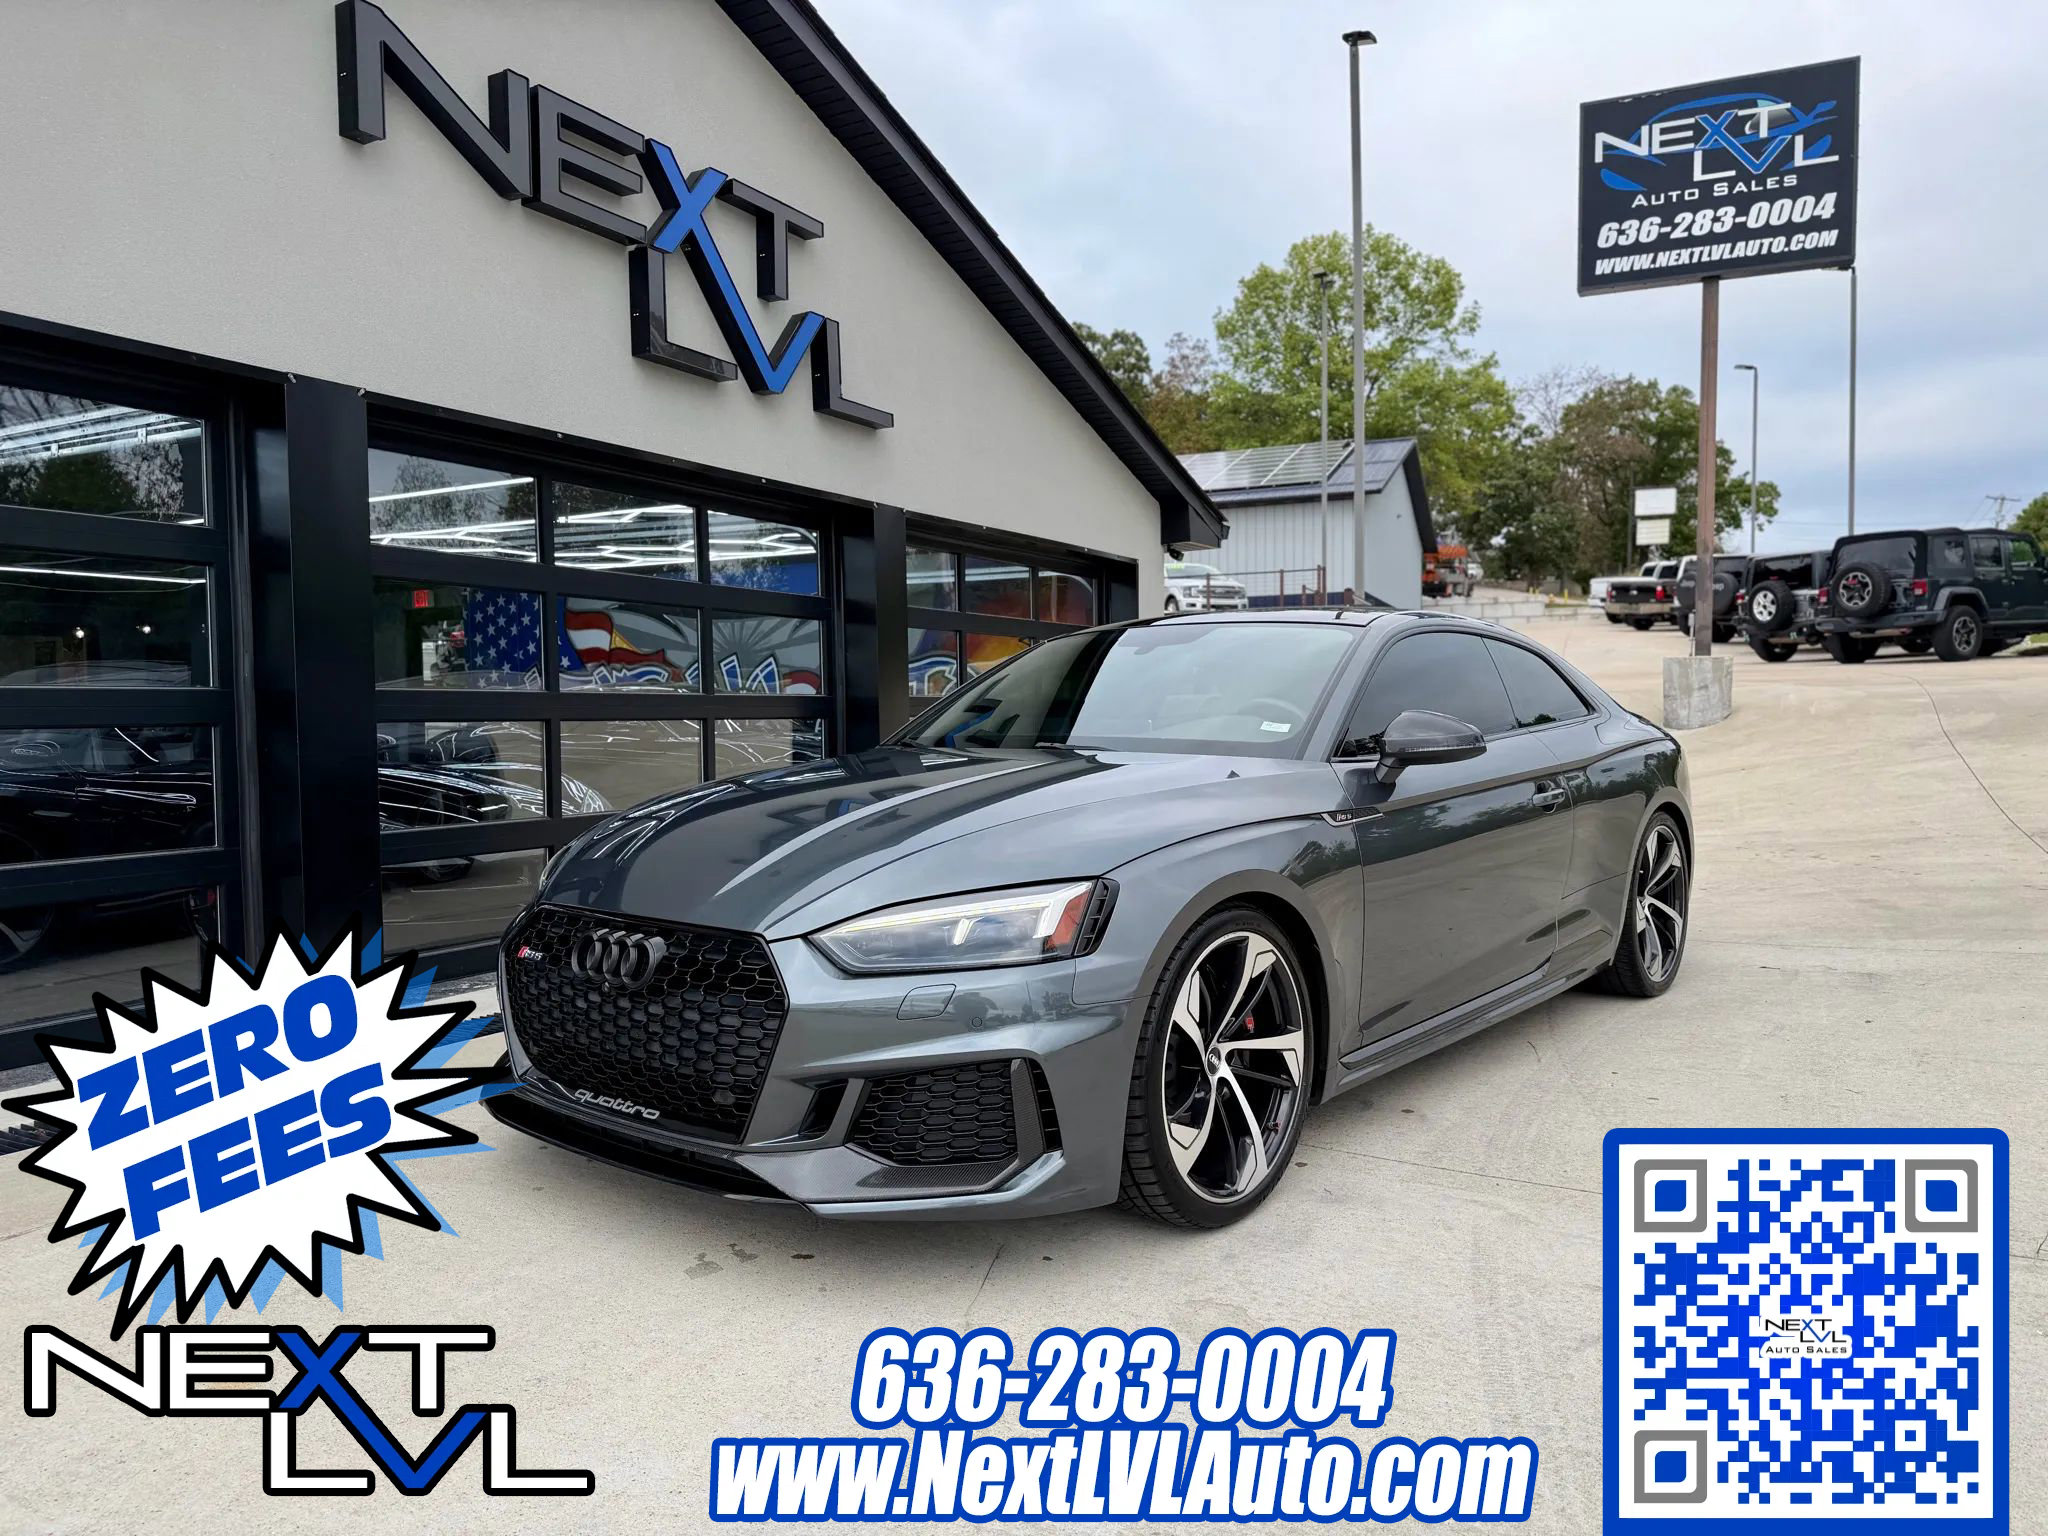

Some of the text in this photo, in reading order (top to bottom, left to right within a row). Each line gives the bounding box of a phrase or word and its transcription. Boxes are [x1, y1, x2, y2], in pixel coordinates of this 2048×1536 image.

[335, 0, 824, 301] NEXT
[1594, 102, 1791, 163] NEXT
[1693, 134, 1839, 182] LVL
[1596, 192, 1838, 248] 636-283-0004
[1594, 229, 1839, 275] WWW.NEXTLVLAUTO.COM
[628, 240, 894, 430] LVL
[574, 1088, 660, 1120] quattro
